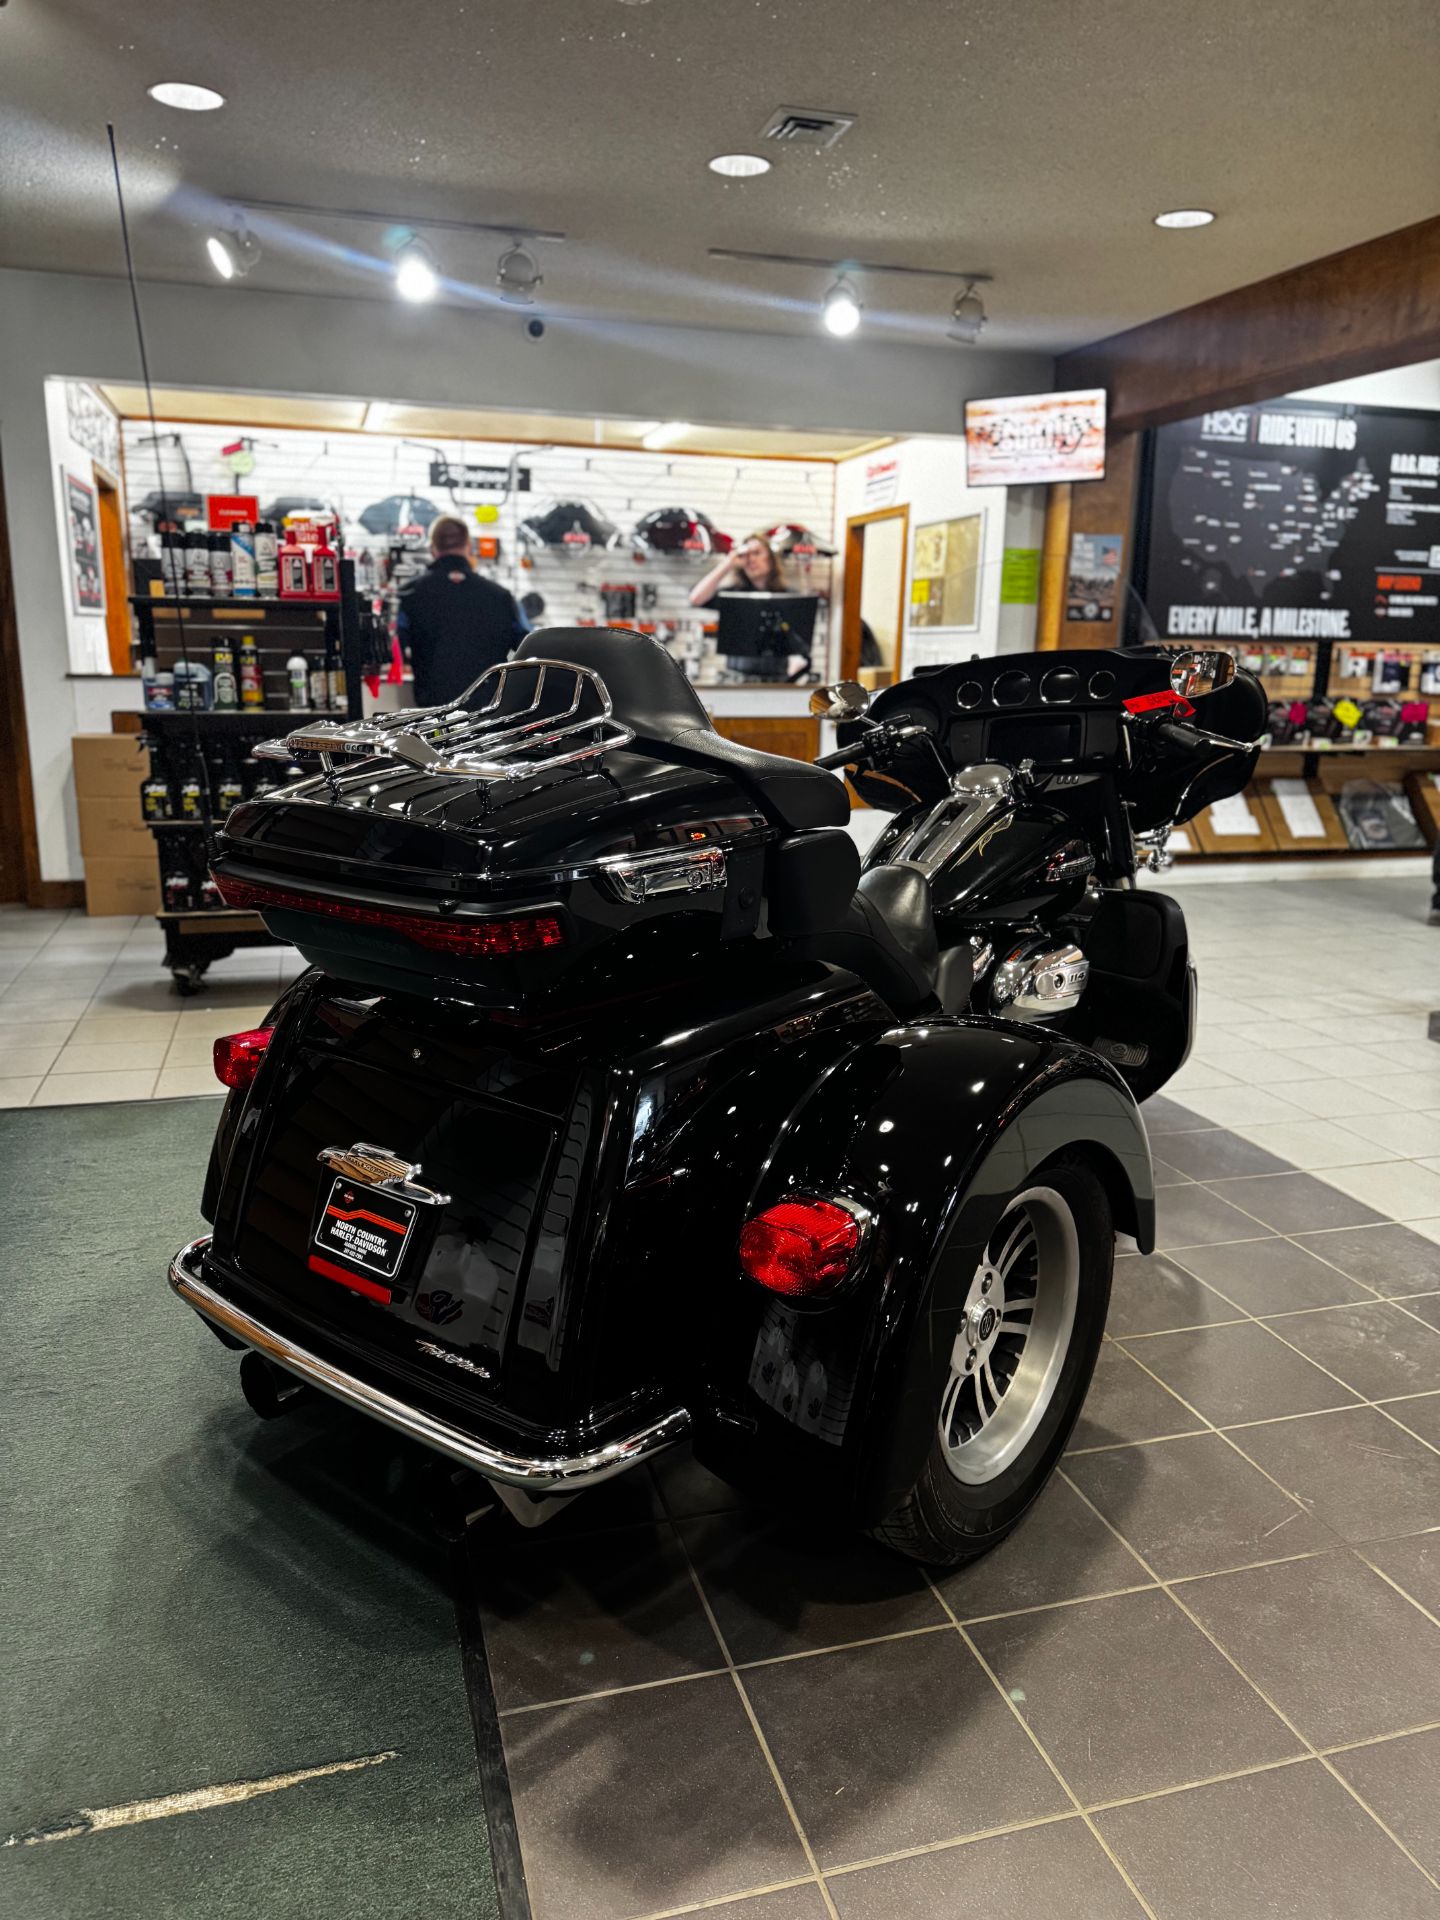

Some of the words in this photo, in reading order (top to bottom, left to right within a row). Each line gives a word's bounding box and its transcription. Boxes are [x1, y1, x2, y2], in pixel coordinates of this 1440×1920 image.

[1258, 414, 1295, 445] RIDE
[1335, 419, 1357, 450] US
[1168, 605, 1216, 635] EVERY
[1216, 606, 1259, 639] MILE,
[1260, 607, 1272, 636] A
[1272, 607, 1351, 638] MILESTONE.
[1070, 972, 1085, 983] 114
[330, 1226, 388, 1257] HARLEY-DAVIDSON
[335, 1219, 357, 1235] NORTH
[356, 1229, 388, 1247] COUNTRY
